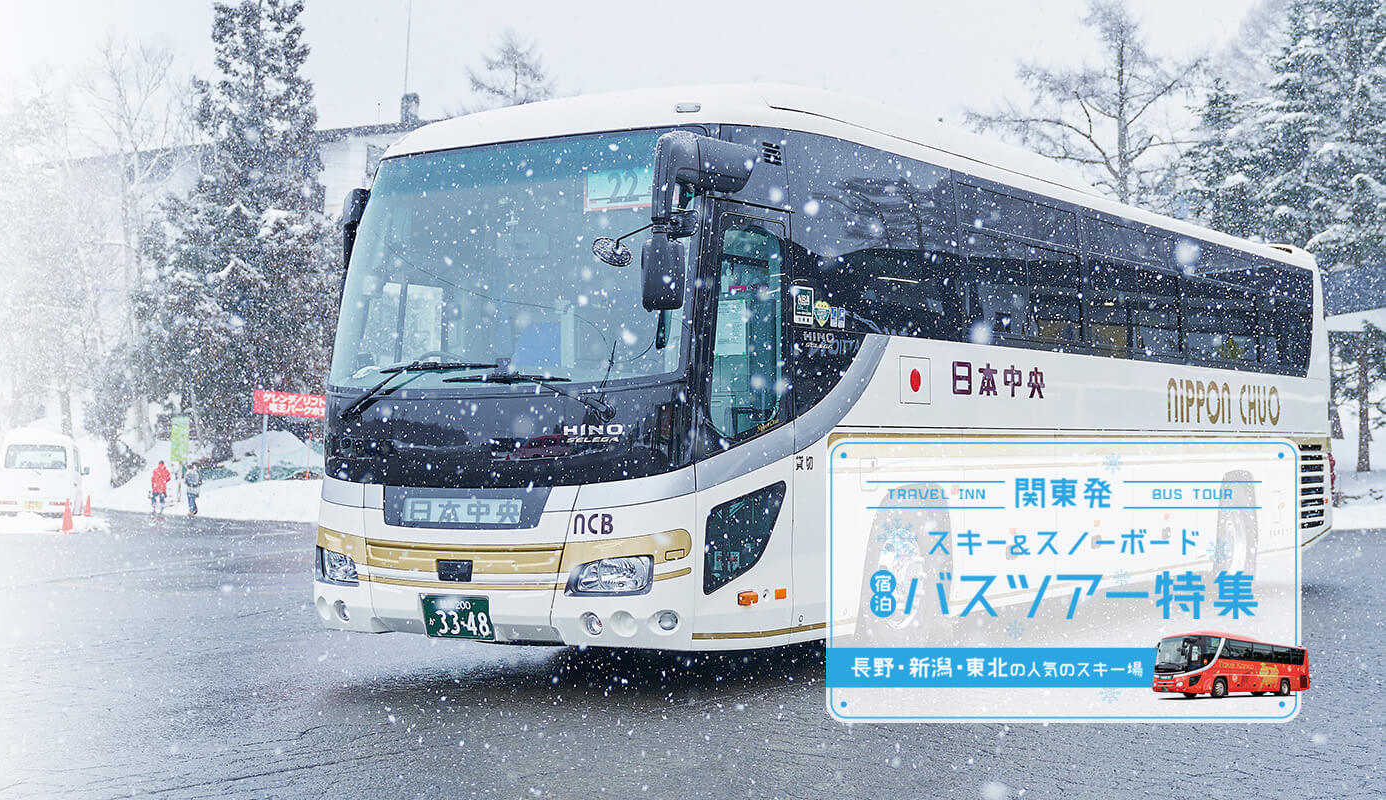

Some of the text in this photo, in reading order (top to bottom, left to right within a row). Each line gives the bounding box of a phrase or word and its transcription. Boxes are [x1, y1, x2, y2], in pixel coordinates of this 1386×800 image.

[607, 169, 640, 204] 22
[803, 331, 834, 343] HINO
[952, 361, 1046, 399] 日本中央
[1167, 377, 1280, 425] NIPPON CHUO
[563, 423, 624, 436] HINO
[566, 436, 620, 444] SELEGA
[795, 456, 814, 471] 貸切
[411, 500, 519, 523] 日本中央
[573, 513, 614, 535] NCB
[456, 601, 472, 610] 200
